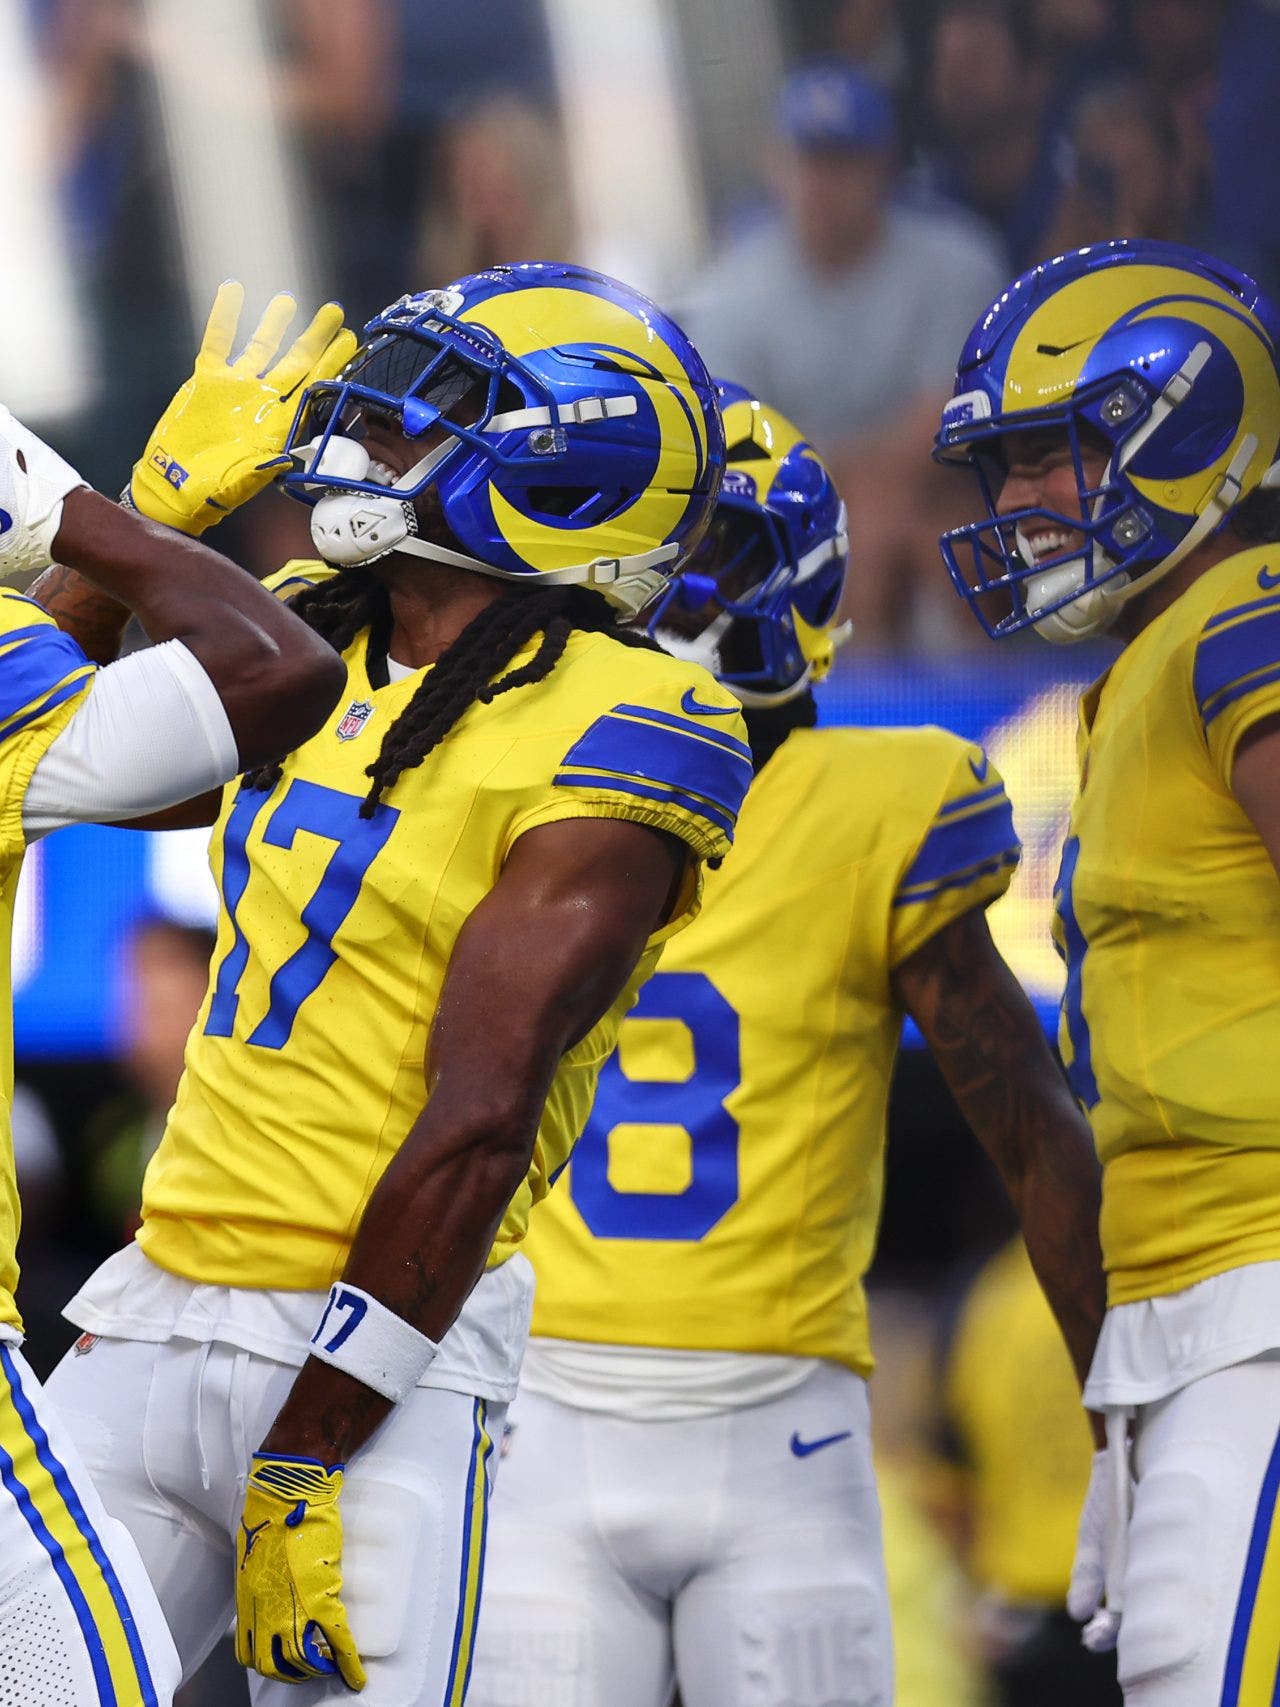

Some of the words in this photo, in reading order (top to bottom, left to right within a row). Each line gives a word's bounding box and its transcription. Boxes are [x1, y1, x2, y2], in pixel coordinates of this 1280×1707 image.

[340, 715, 362, 735] NFL
[203, 772, 402, 1051] 17
[311, 1287, 369, 1354] 17
